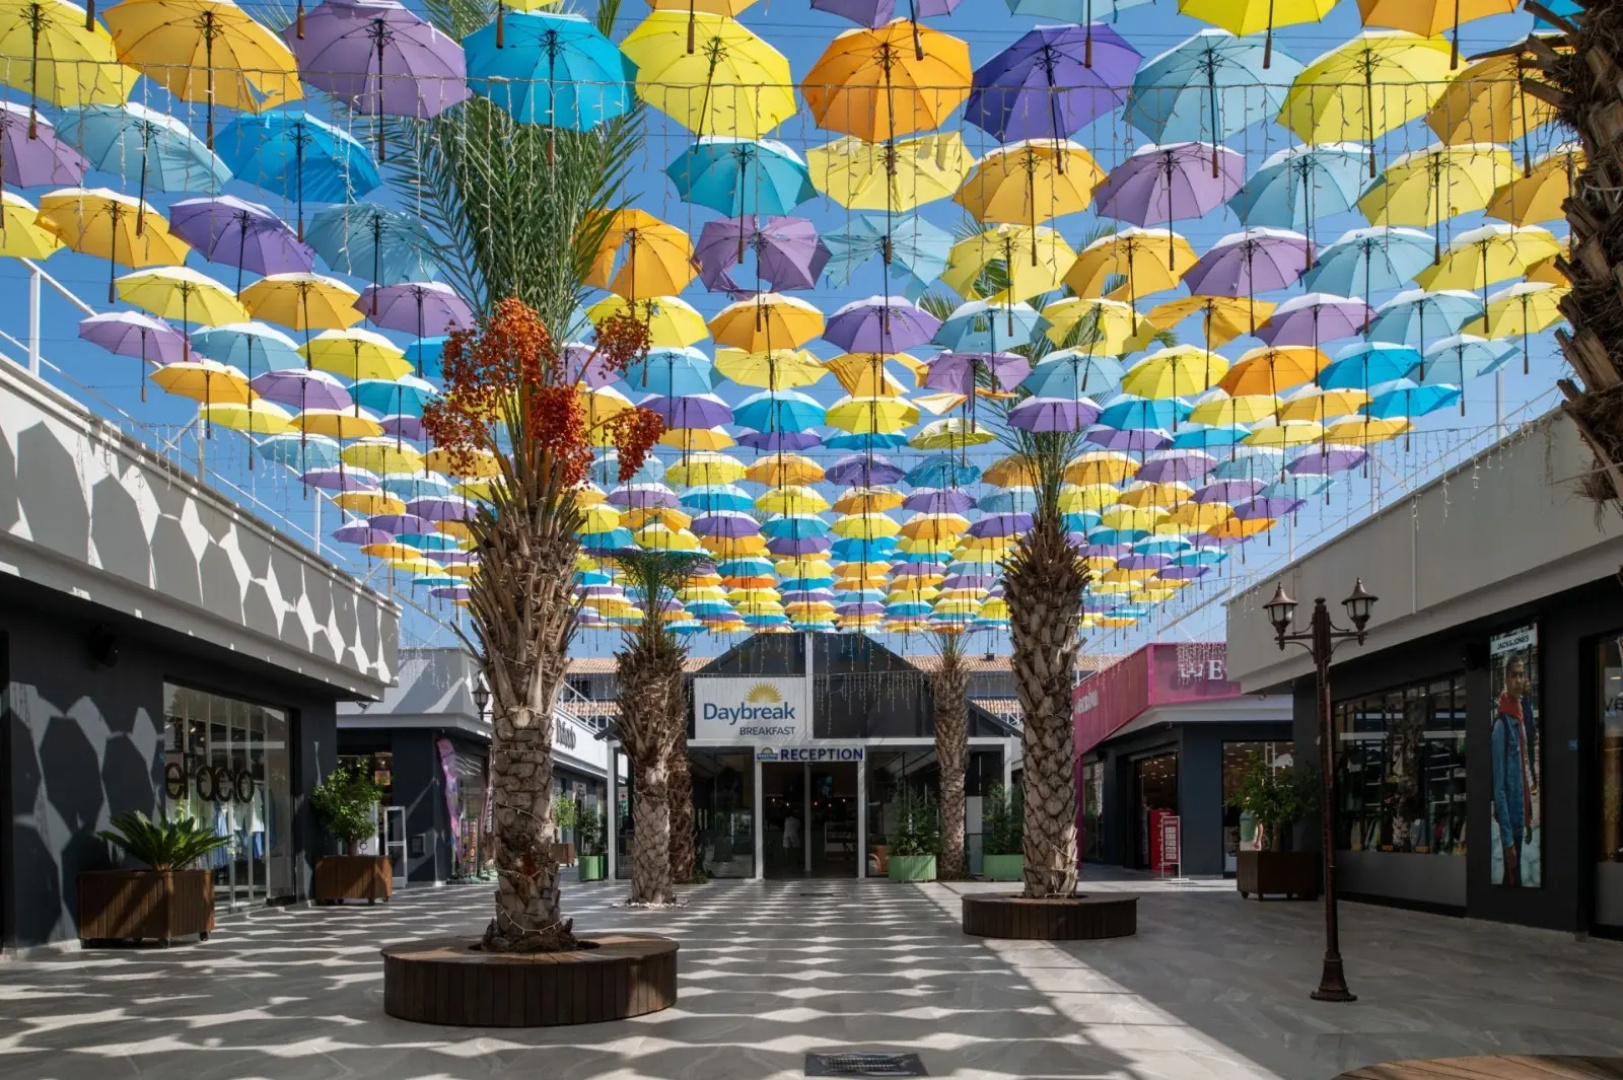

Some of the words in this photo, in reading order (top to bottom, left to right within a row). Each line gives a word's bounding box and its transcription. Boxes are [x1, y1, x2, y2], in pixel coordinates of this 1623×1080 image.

[703, 702, 796, 725] Daybreak
[739, 726, 796, 736] BREAKFAST
[780, 748, 864, 760] RECEPTION
